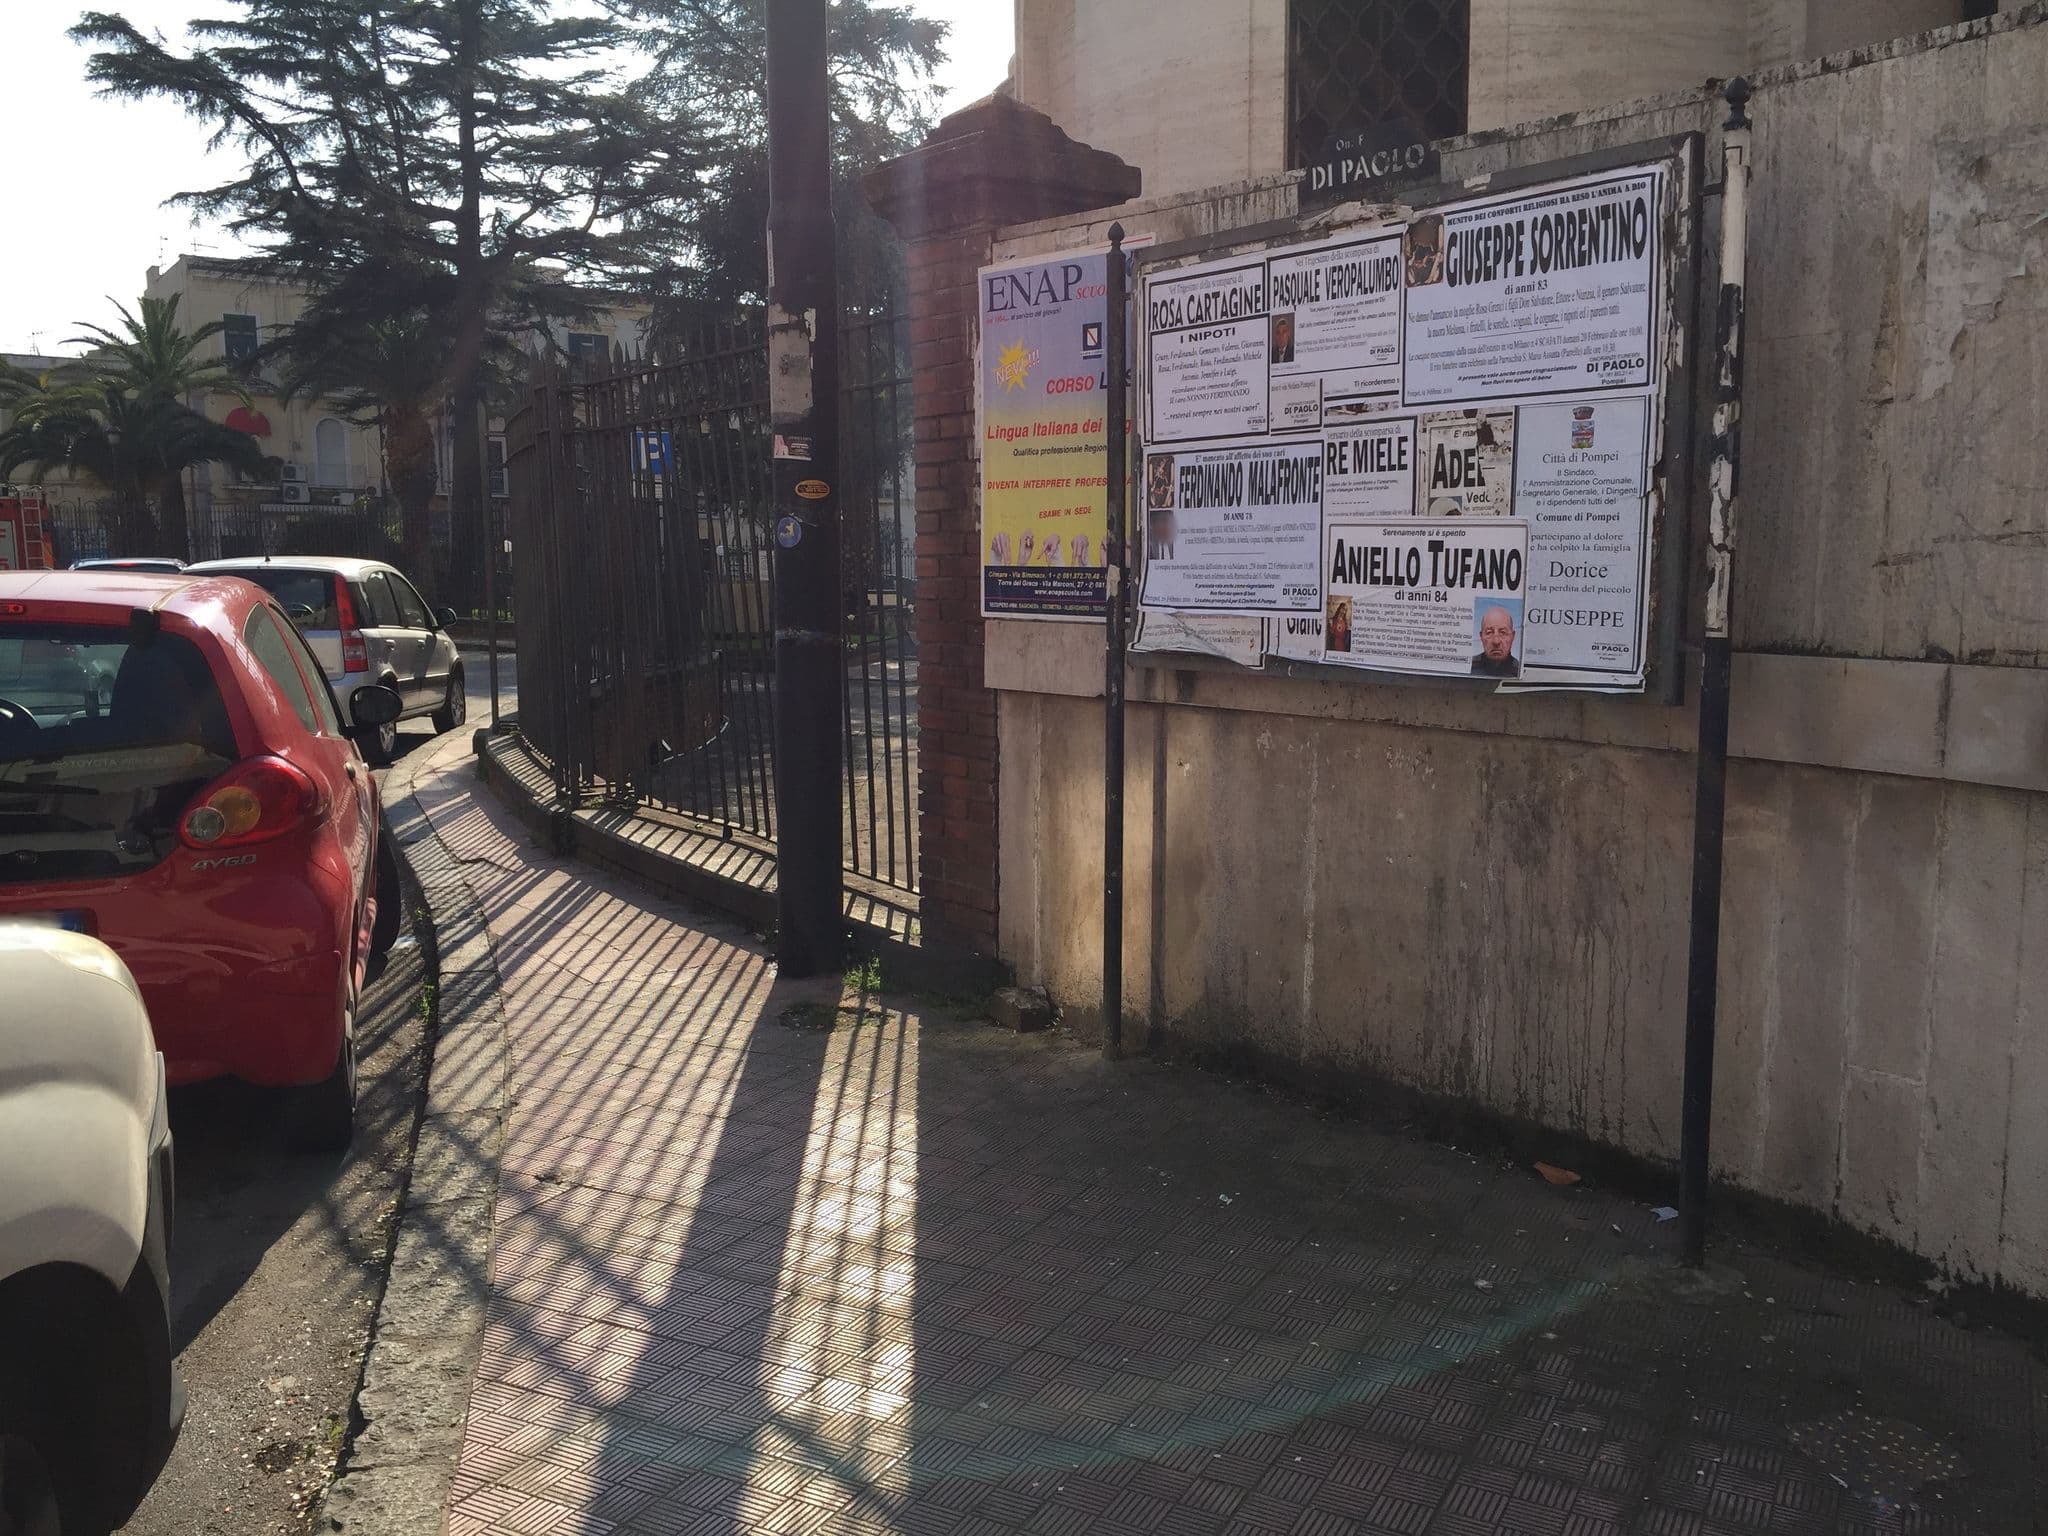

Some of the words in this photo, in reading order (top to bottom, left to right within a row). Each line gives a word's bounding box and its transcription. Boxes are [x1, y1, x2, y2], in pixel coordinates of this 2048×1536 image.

[1312, 163, 1333, 190] DI
[1342, 144, 1424, 184] PAOLO
[1448, 215, 1473, 225] MUNITO
[1475, 213, 1486, 222] DEI
[1488, 207, 1521, 218] CONFORTI
[1523, 199, 1557, 212] RELIGIOSI
[1560, 197, 1570, 205] HA
[1572, 193, 1590, 203] RESO
[1592, 187, 1622, 199] L'ANIMA
[1625, 185, 1630, 193] A
[1632, 181, 1646, 191] DIO
[1447, 220, 1524, 288] GIUSEPPE
[1530, 197, 1647, 275] SORRENTINO
[987, 264, 1082, 312] ENAP
[1076, 285, 1105, 299] SCUO
[1273, 269, 1320, 311] PASQUALE
[1325, 255, 1399, 300] VEROPALUMBO
[1505, 283, 1513, 295] di
[1516, 281, 1535, 293] anni
[1537, 280, 1548, 290] 83
[1152, 298, 1183, 330] ROSA
[1187, 284, 1261, 324] CARTAGINE
[1180, 336, 1183, 344] I
[1189, 327, 1235, 342] NIPOTI
[1587, 363, 1598, 373] DI
[1603, 358, 1644, 371] PAOLO
[1046, 376, 1094, 394] CORSO
[1361, 378, 1395, 387] ricorderemo
[1285, 407, 1292, 415] DI
[1294, 404, 1318, 413] PAOLO
[987, 425, 1028, 442] Lingua
[1033, 421, 1077, 437] Italiana
[1083, 418, 1103, 433] dei
[1013, 447, 1039, 457] Qualifica
[1040, 445, 1083, 456] professionale
[1084, 444, 1108, 454] Region
[1327, 441, 1348, 475] RE
[1353, 436, 1408, 474] MIELE
[1542, 453, 1566, 463] Città
[1569, 452, 1578, 463] di
[1582, 451, 1619, 463] Pompei
[1564, 469, 1596, 477] Sindaco,
[987, 480, 1019, 490] DIVENTA
[1023, 478, 1071, 489] INTERPRETE
[1075, 477, 1108, 487] PROFES
[1179, 462, 1243, 509] FERDINANDO
[1248, 456, 1320, 506] MALAFRONTE
[1529, 479, 1590, 487] Amministrazione
[1592, 477, 1633, 485] Comunale,
[1522, 489, 1560, 497] Segretario
[1606, 487, 1638, 496] Dirigenti
[1547, 499, 1586, 507] dipendenti
[1039, 509, 1061, 519] ESAME
[1064, 508, 1071, 516] IN
[1074, 506, 1092, 515] SEDE
[1536, 513, 1572, 521] Comune
[1574, 512, 1583, 521] di
[1586, 512, 1620, 523] Pompei
[1383, 528, 1426, 537] Serenamente
[1428, 529, 1434, 537] si
[1442, 529, 1466, 538] spento
[1531, 533, 1581, 542] partecipano
[1550, 544, 1580, 552] colpito
[1593, 544, 1631, 553] famiglia
[1332, 538, 1420, 587] ANIELLO
[1427, 540, 1522, 591] TUFANO
[1550, 561, 1608, 578] Dorice
[1395, 590, 1404, 600] di
[1407, 591, 1432, 602] anni
[1434, 591, 1448, 603] 84
[1540, 584, 1546, 592] la
[1549, 584, 1579, 593] perdita
[1581, 585, 1595, 593] del
[1598, 586, 1631, 595] piccolo
[1528, 608, 1624, 628] GIUSEPPE
[191, 854, 257, 871] AYGO
